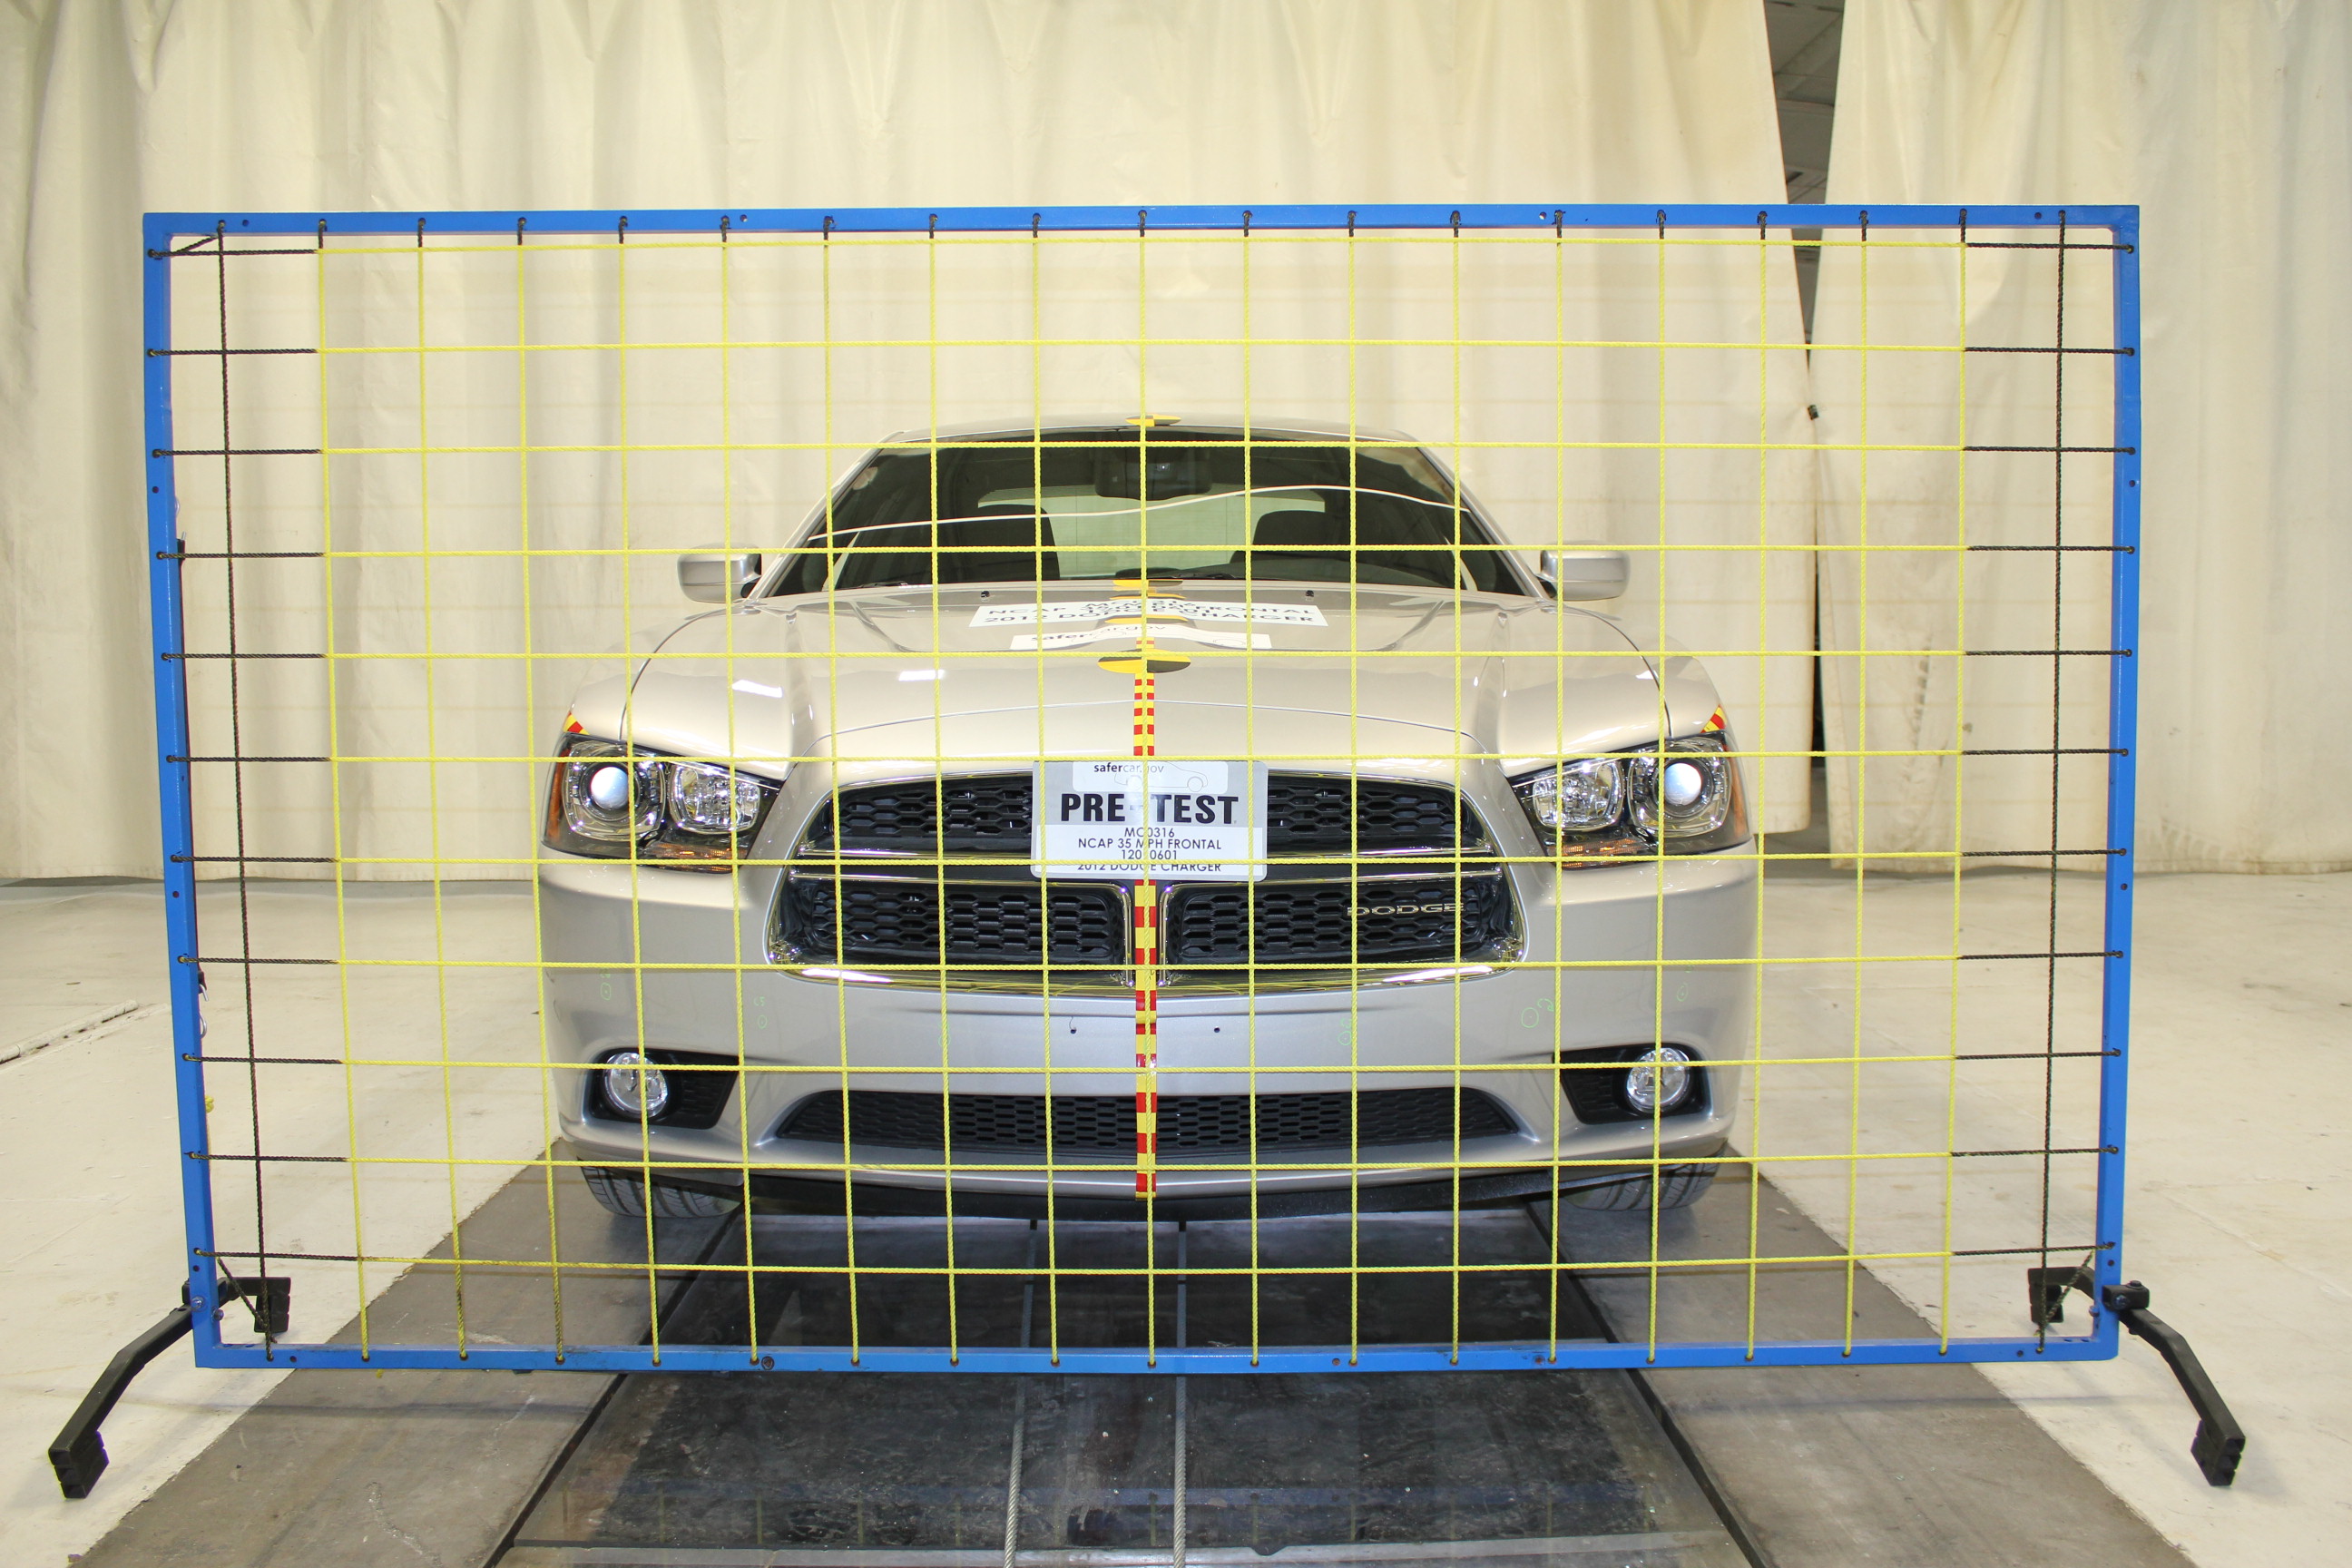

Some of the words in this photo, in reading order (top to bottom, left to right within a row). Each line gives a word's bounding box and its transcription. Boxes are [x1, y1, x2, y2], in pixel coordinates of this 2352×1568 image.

[1093, 761, 1164, 773] safercar.ov
[1078, 838, 1113, 848] NCAP
[1117, 838, 1132, 848] 35
[1167, 839, 1222, 849] FRONTAL
[1122, 849, 1178, 860] 1200601
[1347, 902, 1465, 916] DODGE
